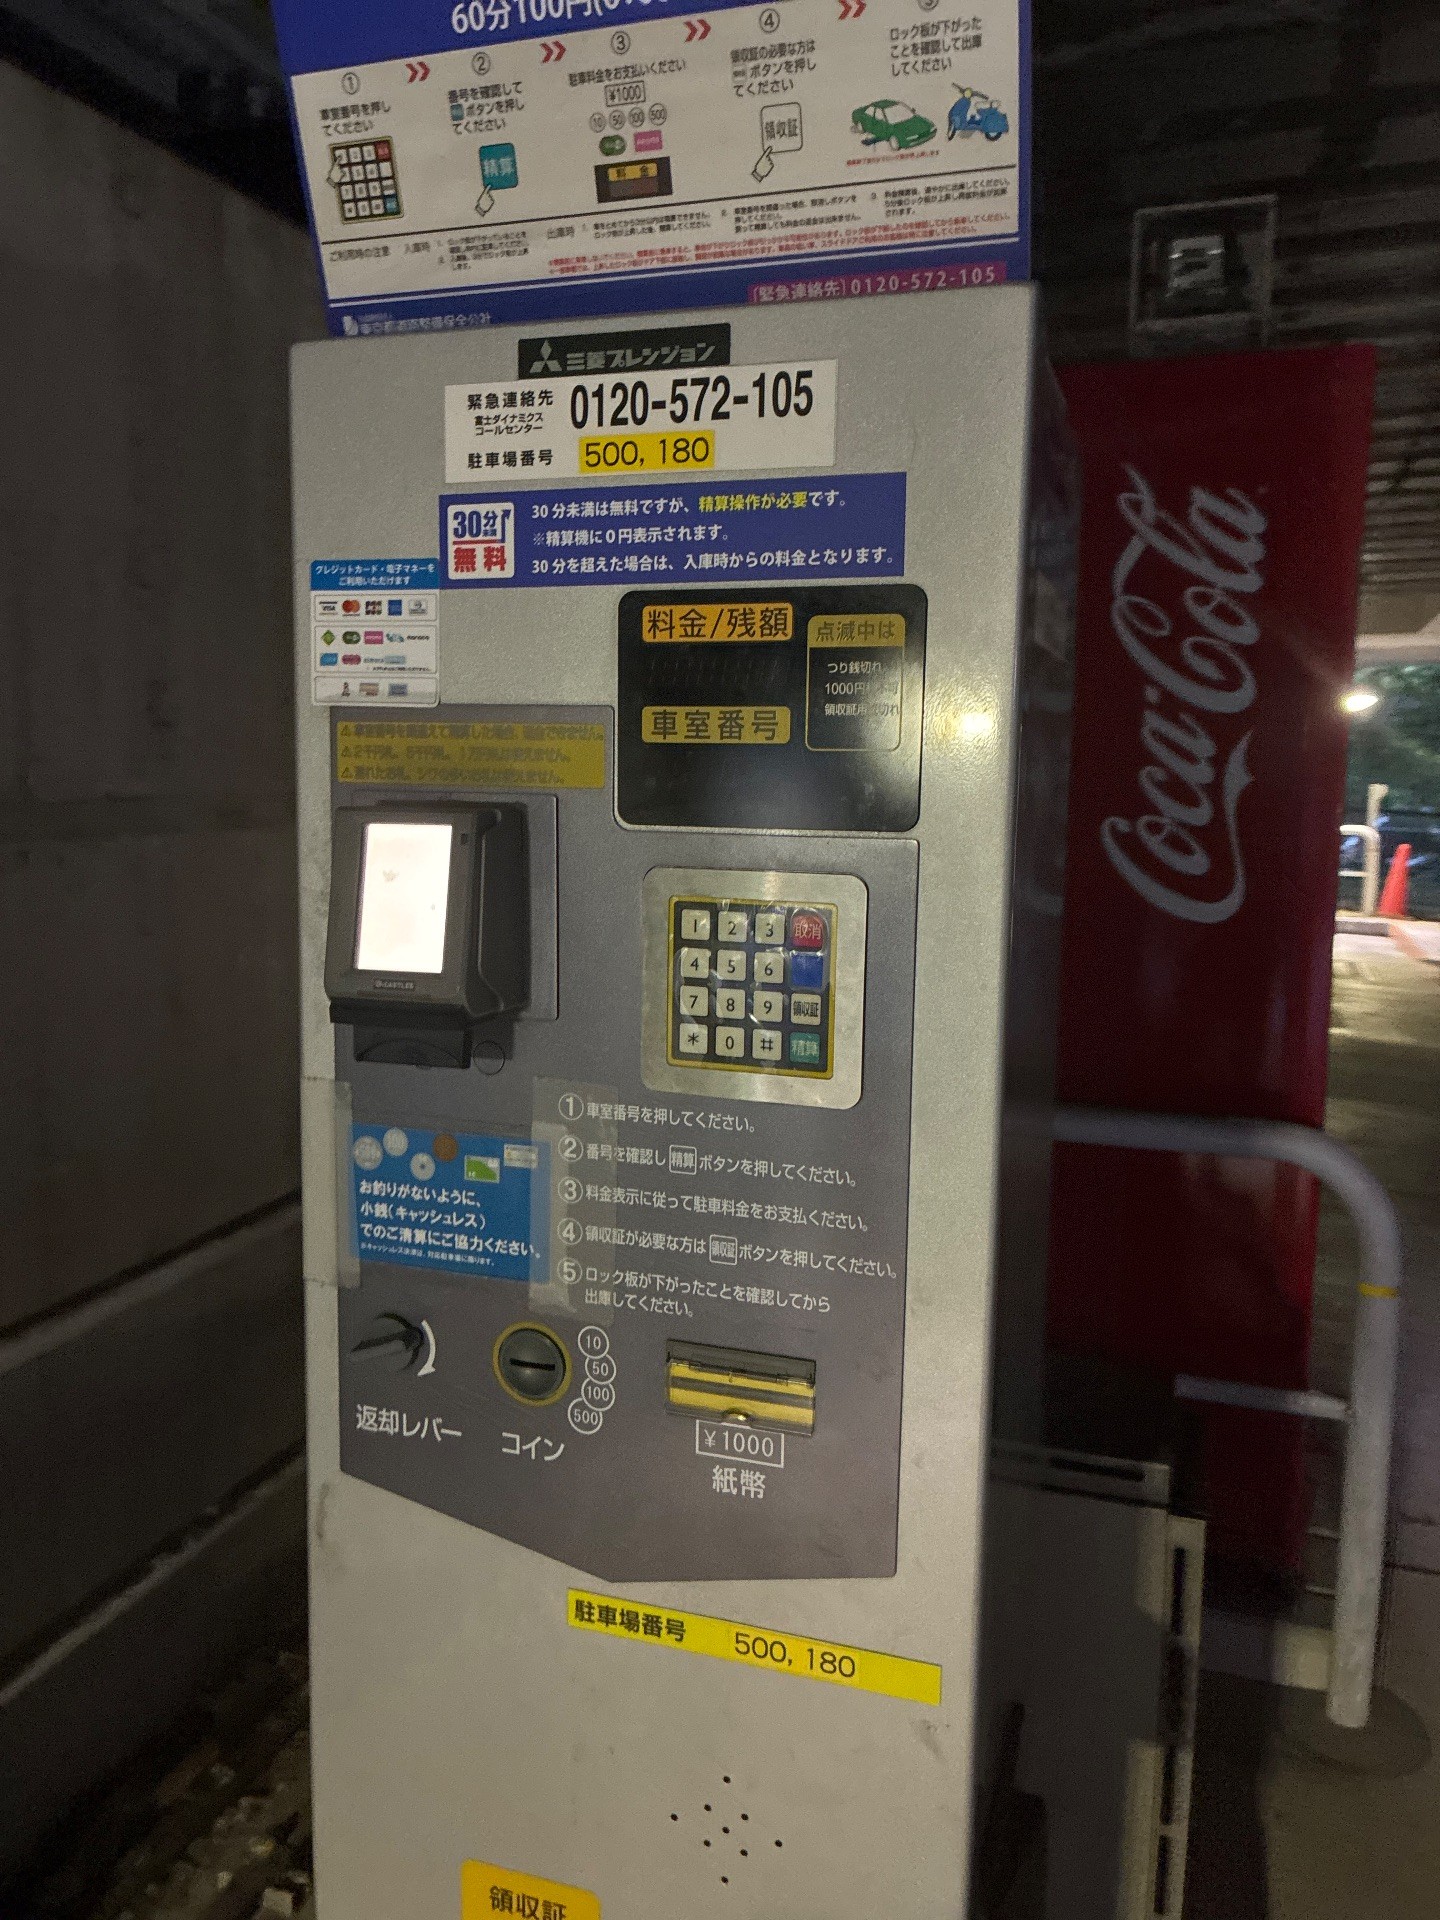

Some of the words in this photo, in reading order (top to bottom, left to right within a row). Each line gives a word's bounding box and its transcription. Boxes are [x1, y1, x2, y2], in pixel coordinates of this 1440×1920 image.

[890, 15, 982, 42] ロック板が下がった
[730, 39, 816, 64] 領収証の必要な方は
[890, 33, 982, 59] ことを確認して出庫
[891, 57, 952, 77] してください
[448, 81, 523, 103] 番号を確認して
[734, 78, 794, 98] てください
[319, 101, 391, 121] 車室番号を押し
[322, 121, 373, 136] てください
[452, 117, 506, 135] てください
[764, 118, 798, 141] 領収証
[483, 157, 514, 178] 精算
[851, 266, 996, 295] 0120-572-105
[467, 389, 554, 411] 緊急連絡先
[570, 370, 813, 430] 0120-572-105
[474, 412, 544, 427] 富士ダイナミクス
[475, 424, 543, 438] コールセンター
[467, 449, 554, 470] 駐車場番号
[659, 436, 710, 464] 180
[453, 545, 506, 572] 無料
[647, 606, 789, 639] 料金/残額
[815, 619, 896, 642] 点滅中は
[827, 661, 882, 675] つり銭切れ
[651, 709, 779, 741] 車室番号
[728, 923, 737, 936] 2
[765, 923, 774, 938] 3
[794, 921, 823, 940] 取消
[690, 957, 699, 971] 4
[727, 960, 736, 973] 5
[764, 962, 773, 976] 6
[689, 995, 699, 1009] 7
[726, 998, 735, 1012] 8
[764, 1000, 773, 1014] 9
[793, 1001, 819, 1018] 領収証
[725, 1036, 734, 1050] 0
[791, 1039, 819, 1056] 精算
[586, 1103, 756, 1133] 車室番号を押してください。
[359, 1179, 481, 1208] お釣りがないように、
[586, 1185, 869, 1232] 料金表示に従って駐車料金をお支払ください。
[360, 1223, 541, 1259] でのご清算にご協力ください。
[586, 1266, 830, 1313] ロック板が下がったことを確認してから
[585, 1289, 694, 1318] 出庫してください。
[585, 1334, 601, 1350] 10
[592, 1361, 610, 1377] 50
[587, 1387, 610, 1403] 100
[356, 1404, 462, 1441] 返却レバー
[573, 1410, 599, 1427] 500
[501, 1431, 565, 1461] コイン
[713, 1465, 766, 1499] 紙幣
[575, 1599, 686, 1643] 駐車場番号
[807, 1648, 856, 1678] 180
[490, 1885, 566, 1920] 領収証
